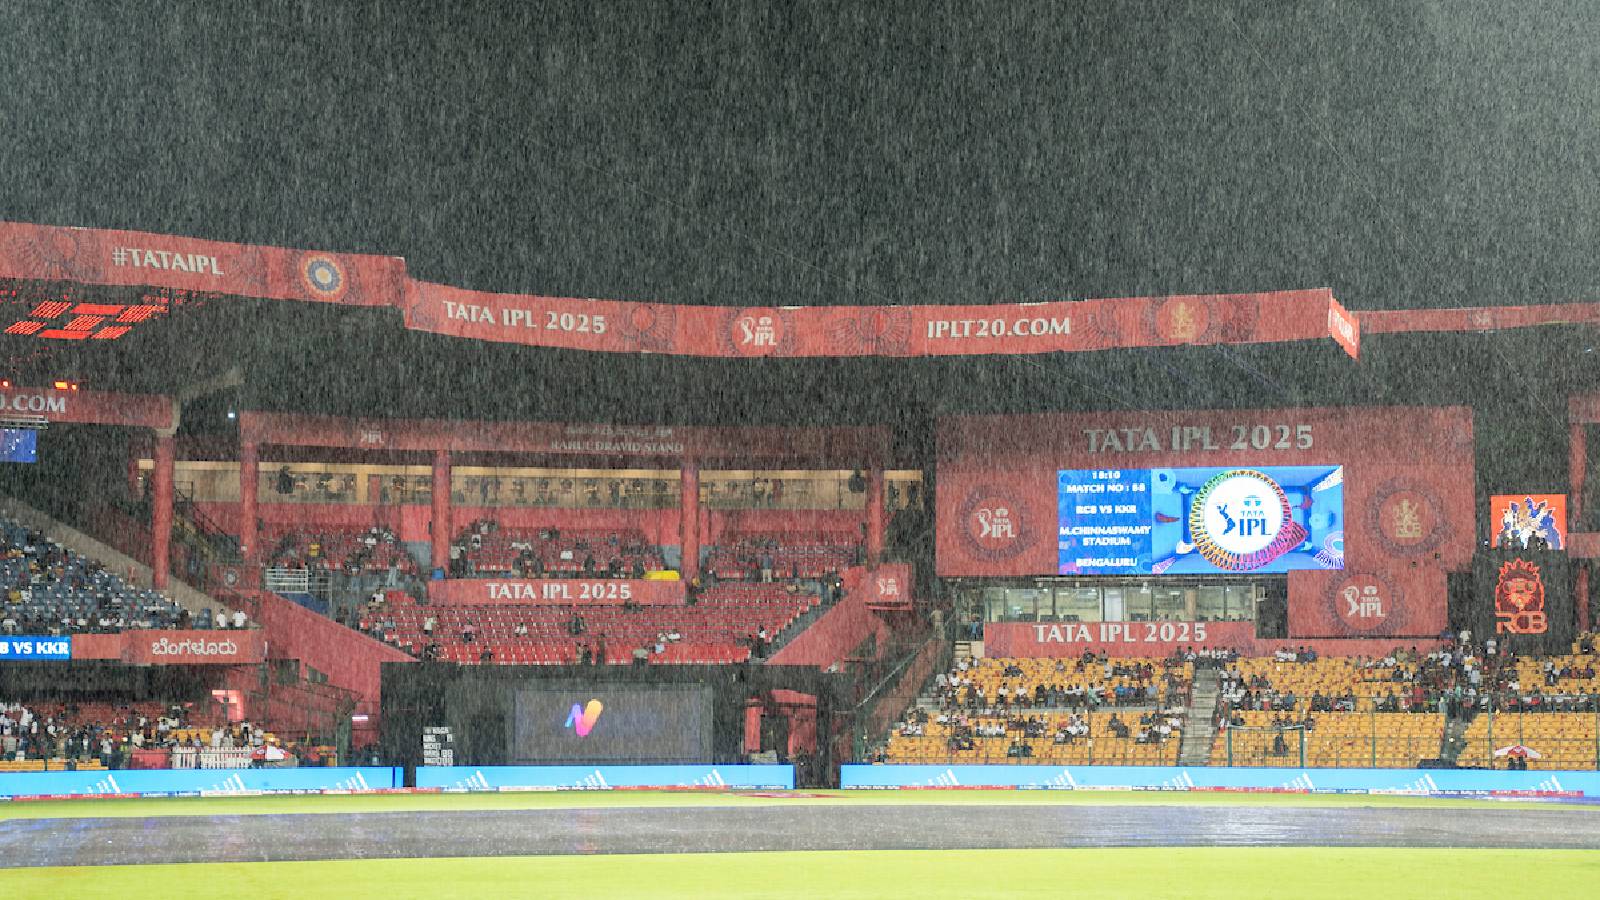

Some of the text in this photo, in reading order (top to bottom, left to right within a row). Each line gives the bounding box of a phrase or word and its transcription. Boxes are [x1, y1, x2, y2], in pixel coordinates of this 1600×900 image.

[111, 245, 225, 276] #TATAIPL
[442, 299, 606, 335] TATA IPL 2025
[927, 317, 1071, 339] IPLT20.COM
[754, 332, 777, 346] IPL
[595, 440, 641, 452] DRAVID
[644, 441, 684, 454] STAND
[1083, 424, 1315, 453] TATA IPL 2025
[992, 524, 1016, 538] IPL
[1239, 518, 1272, 536] IPL
[1082, 537, 1132, 546] STADIUM
[1075, 557, 1138, 567] BENGALURU
[486, 582, 632, 599] TATA IPL 2025
[1360, 602, 1385, 618] IPL
[1495, 611, 1548, 634] RCB
[1032, 623, 1208, 643] TATA IPL 2025
[12, 641, 33, 655] VS
[36, 641, 69, 655] KKR
